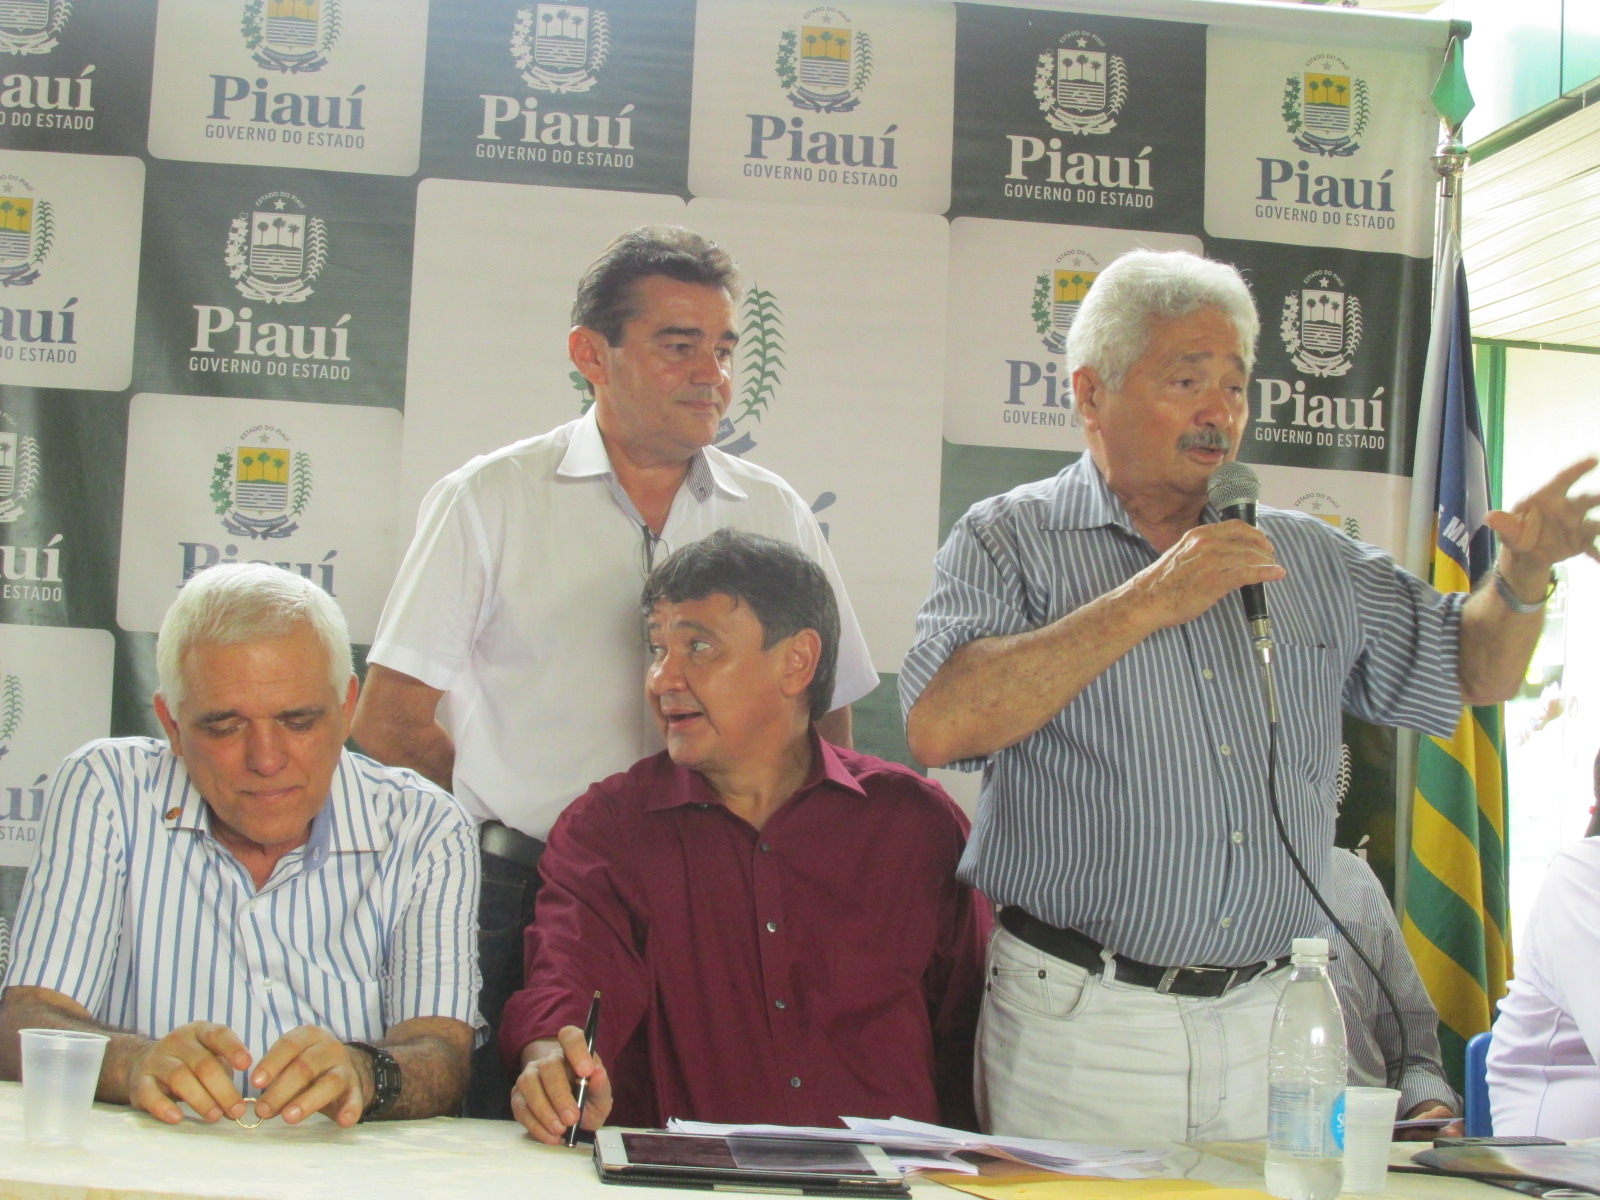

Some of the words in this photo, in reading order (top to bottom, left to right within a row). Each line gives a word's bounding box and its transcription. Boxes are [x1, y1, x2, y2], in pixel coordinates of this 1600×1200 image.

[0, 64, 96, 111] auí
[206, 74, 366, 130] Piauí
[12, 112, 31, 127] DO
[36, 113, 95, 130] ESTADO
[476, 94, 635, 150] Piauí
[205, 124, 277, 142] GOVERNO
[282, 129, 303, 144] DO
[307, 132, 365, 149] ESTADO
[744, 113, 898, 169] Piauí
[476, 143, 547, 162] GOVERNO
[552, 149, 572, 164] DO
[577, 151, 634, 169] ESTADO
[1004, 134, 1154, 190] Piauí
[743, 163, 813, 181] GOVERNO
[818, 169, 837, 184] DO
[842, 171, 898, 188] ESTADO
[1255, 157, 1395, 212] Piauí
[1004, 183, 1072, 202] GOVERNO
[1077, 189, 1096, 204] DO
[1100, 191, 1154, 209] ESTADO
[1255, 204, 1318, 223] GOVERNO
[1322, 211, 1341, 225] DO
[1345, 213, 1395, 230] ESTADO
[0, 297, 78, 344] auí
[190, 305, 352, 361] Piauí
[19, 346, 77, 364] ESTADO
[189, 356, 261, 375] GOVERNO
[266, 361, 287, 377] DO
[292, 363, 350, 381] ESTADO
[1003, 409, 1066, 427] GOVERNO
[1255, 378, 1385, 432] Piauí
[1255, 427, 1313, 445] GOVERNO
[1316, 432, 1333, 447] DO
[1337, 433, 1385, 450] ESTADO
[3, 584, 62, 602] ESTADO
[0, 825, 36, 842] STAD
